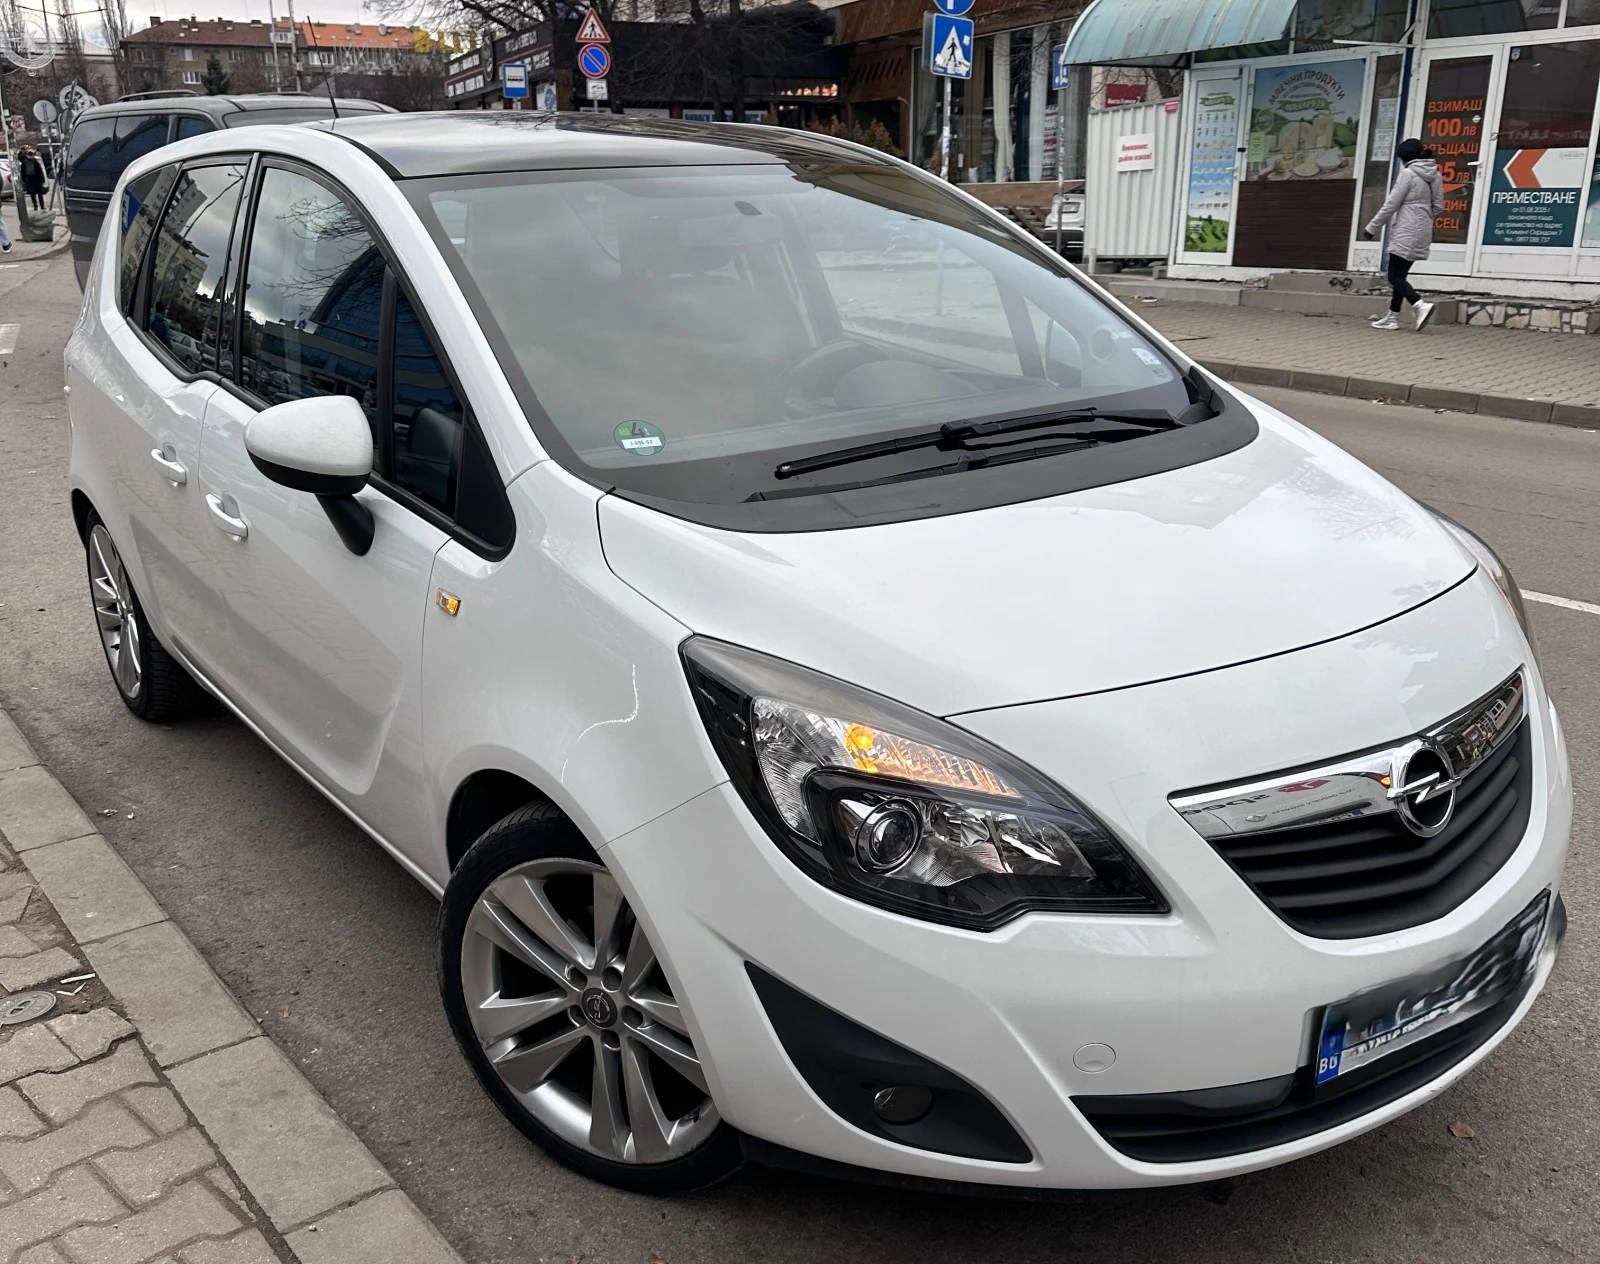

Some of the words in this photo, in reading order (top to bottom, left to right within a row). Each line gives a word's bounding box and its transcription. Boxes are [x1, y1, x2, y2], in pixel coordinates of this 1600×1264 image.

[1268, 72, 1303, 105] МЛЕЧНИ
[1304, 69, 1346, 100] ПРОДУКТИ
[1428, 99, 1483, 113] ВЗИМАШ
[1428, 118, 1462, 137] 100
[1492, 191, 1576, 204] ПРЕМЕСТВАНЕ
[1442, 199, 1467, 212] ДИН
[1433, 217, 1459, 230] СЕЦ
[631, 421, 646, 438] 4
